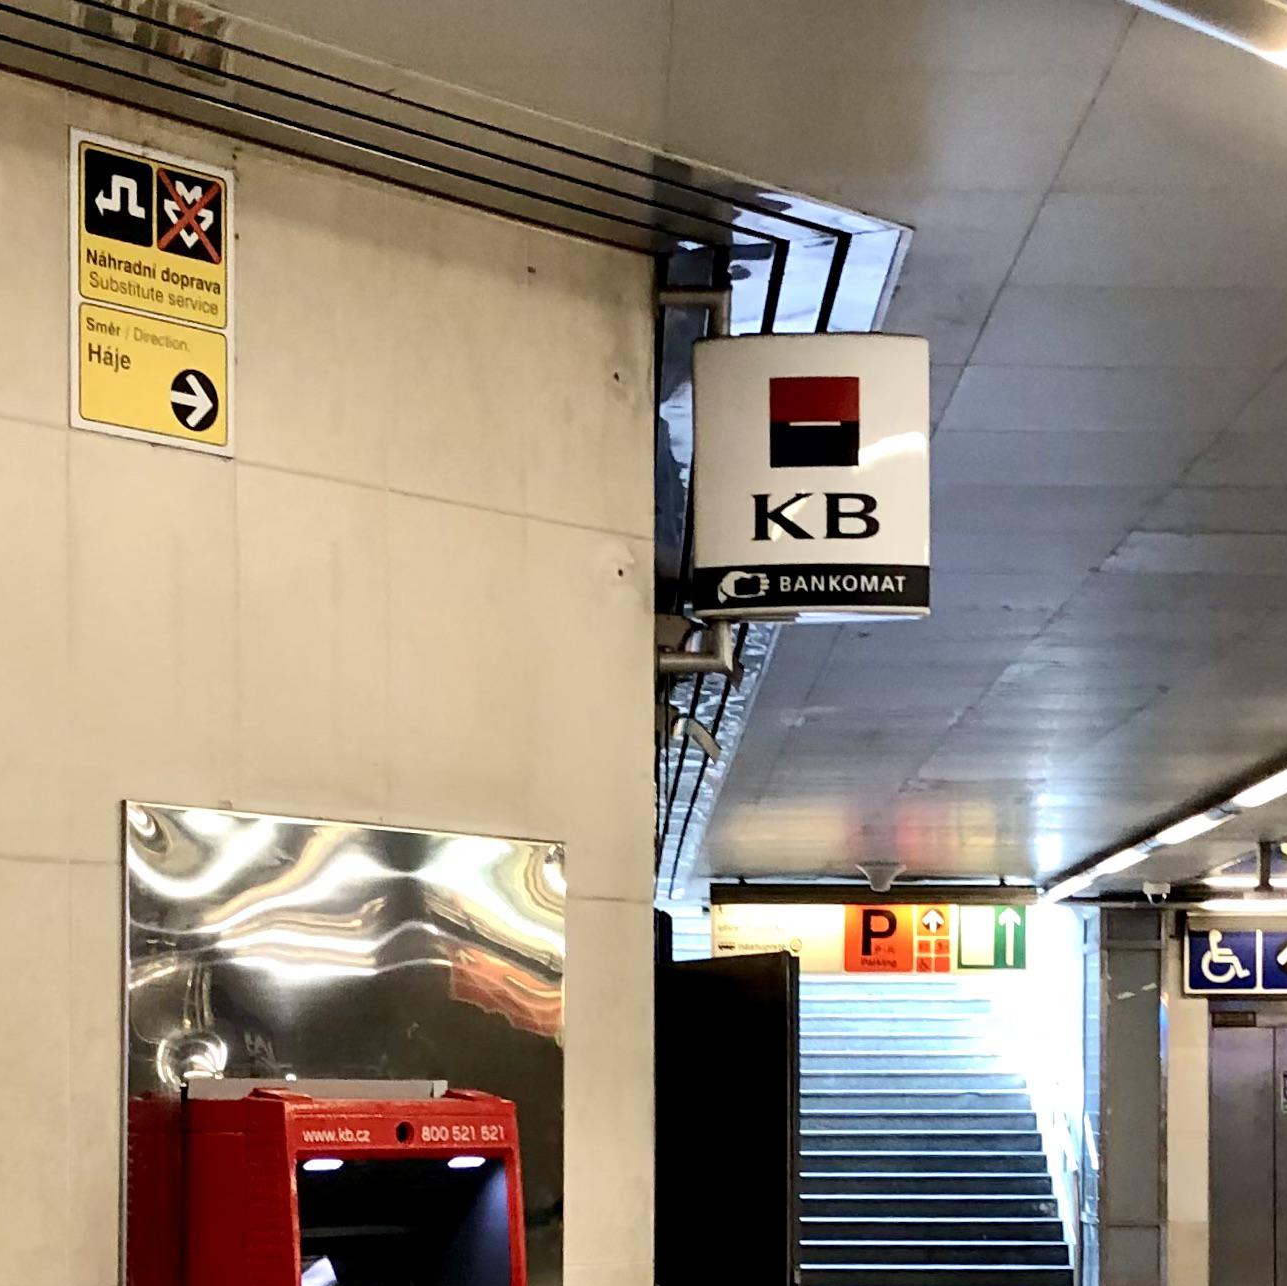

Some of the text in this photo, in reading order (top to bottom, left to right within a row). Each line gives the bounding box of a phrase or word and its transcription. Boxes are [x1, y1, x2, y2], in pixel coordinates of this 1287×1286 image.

[86, 248, 221, 294] Náhradní doprava
[89, 271, 219, 315] Substitute service
[88, 343, 131, 373] Háje
[751, 492, 880, 541] KB
[779, 575, 907, 593] BANKOMAT
[861, 909, 898, 956] P
[302, 1125, 505, 1143] www.kb.cz 800 521 521
